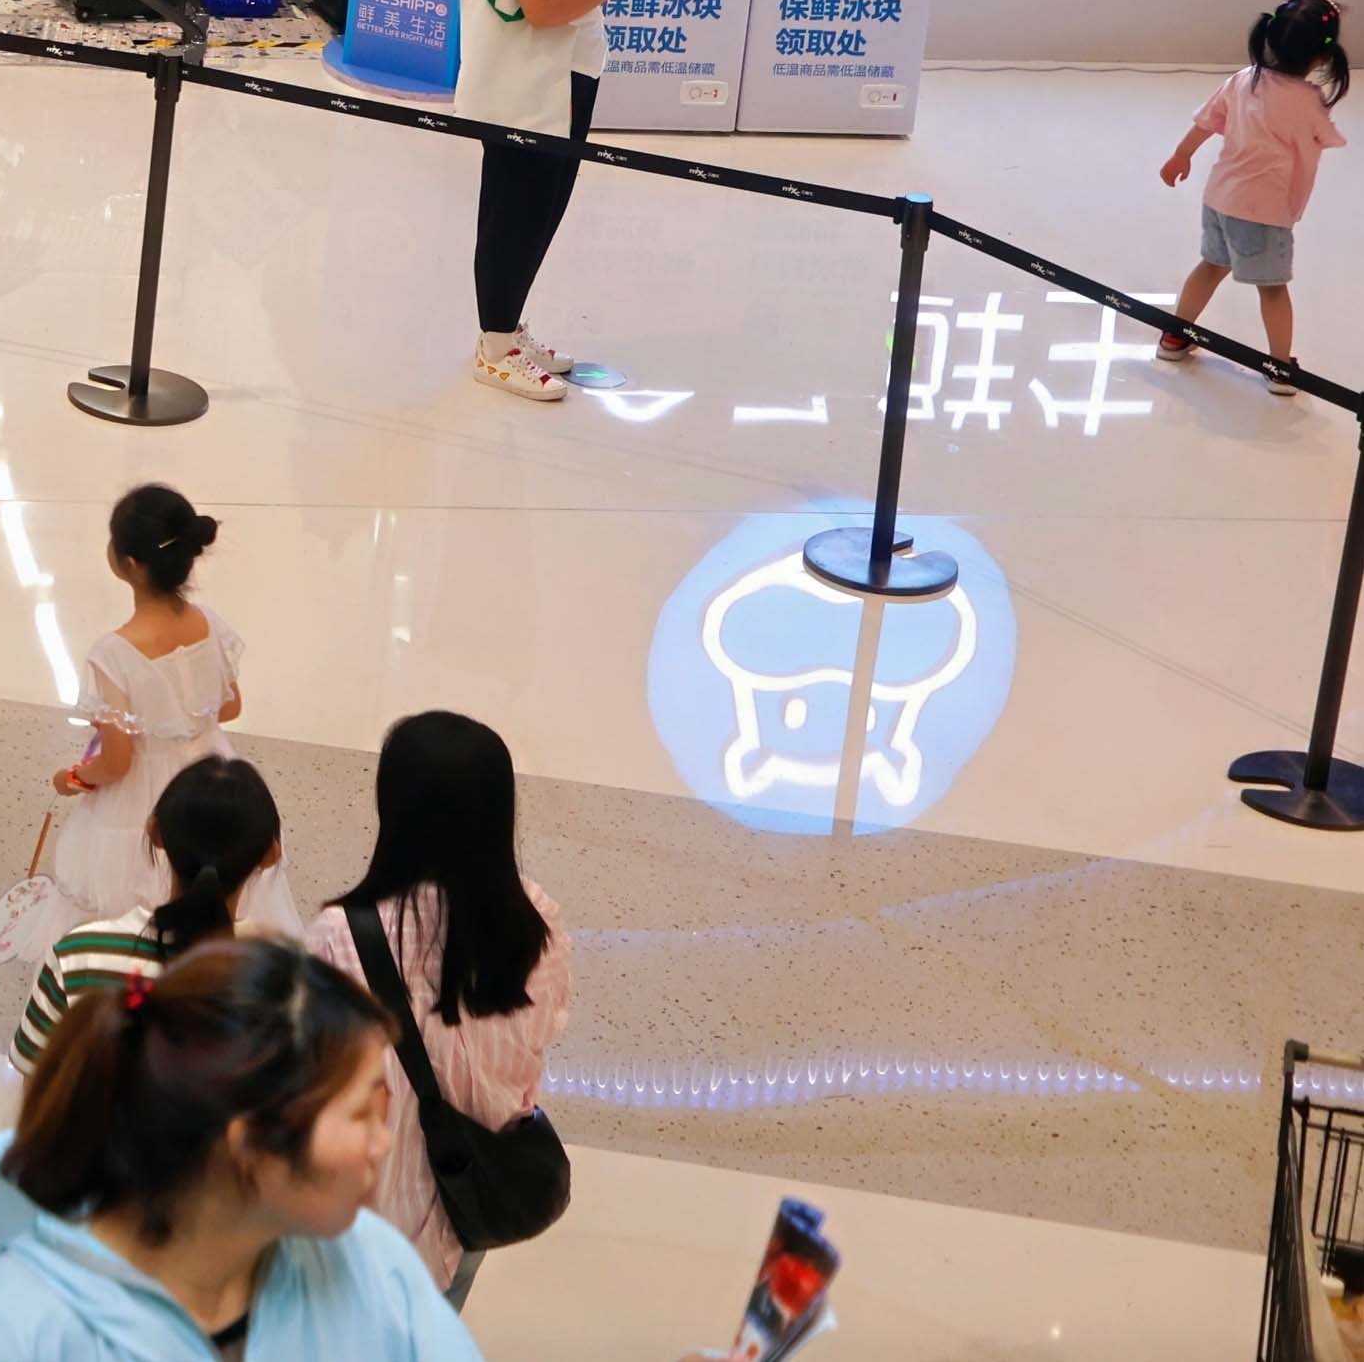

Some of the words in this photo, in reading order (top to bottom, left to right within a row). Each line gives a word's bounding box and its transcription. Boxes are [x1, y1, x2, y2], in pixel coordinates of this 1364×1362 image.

[775, 27, 867, 57] 领取处
[604, 59, 716, 76] 温商品需低温储藏
[772, 62, 896, 79] 低温商品需低温储藏
